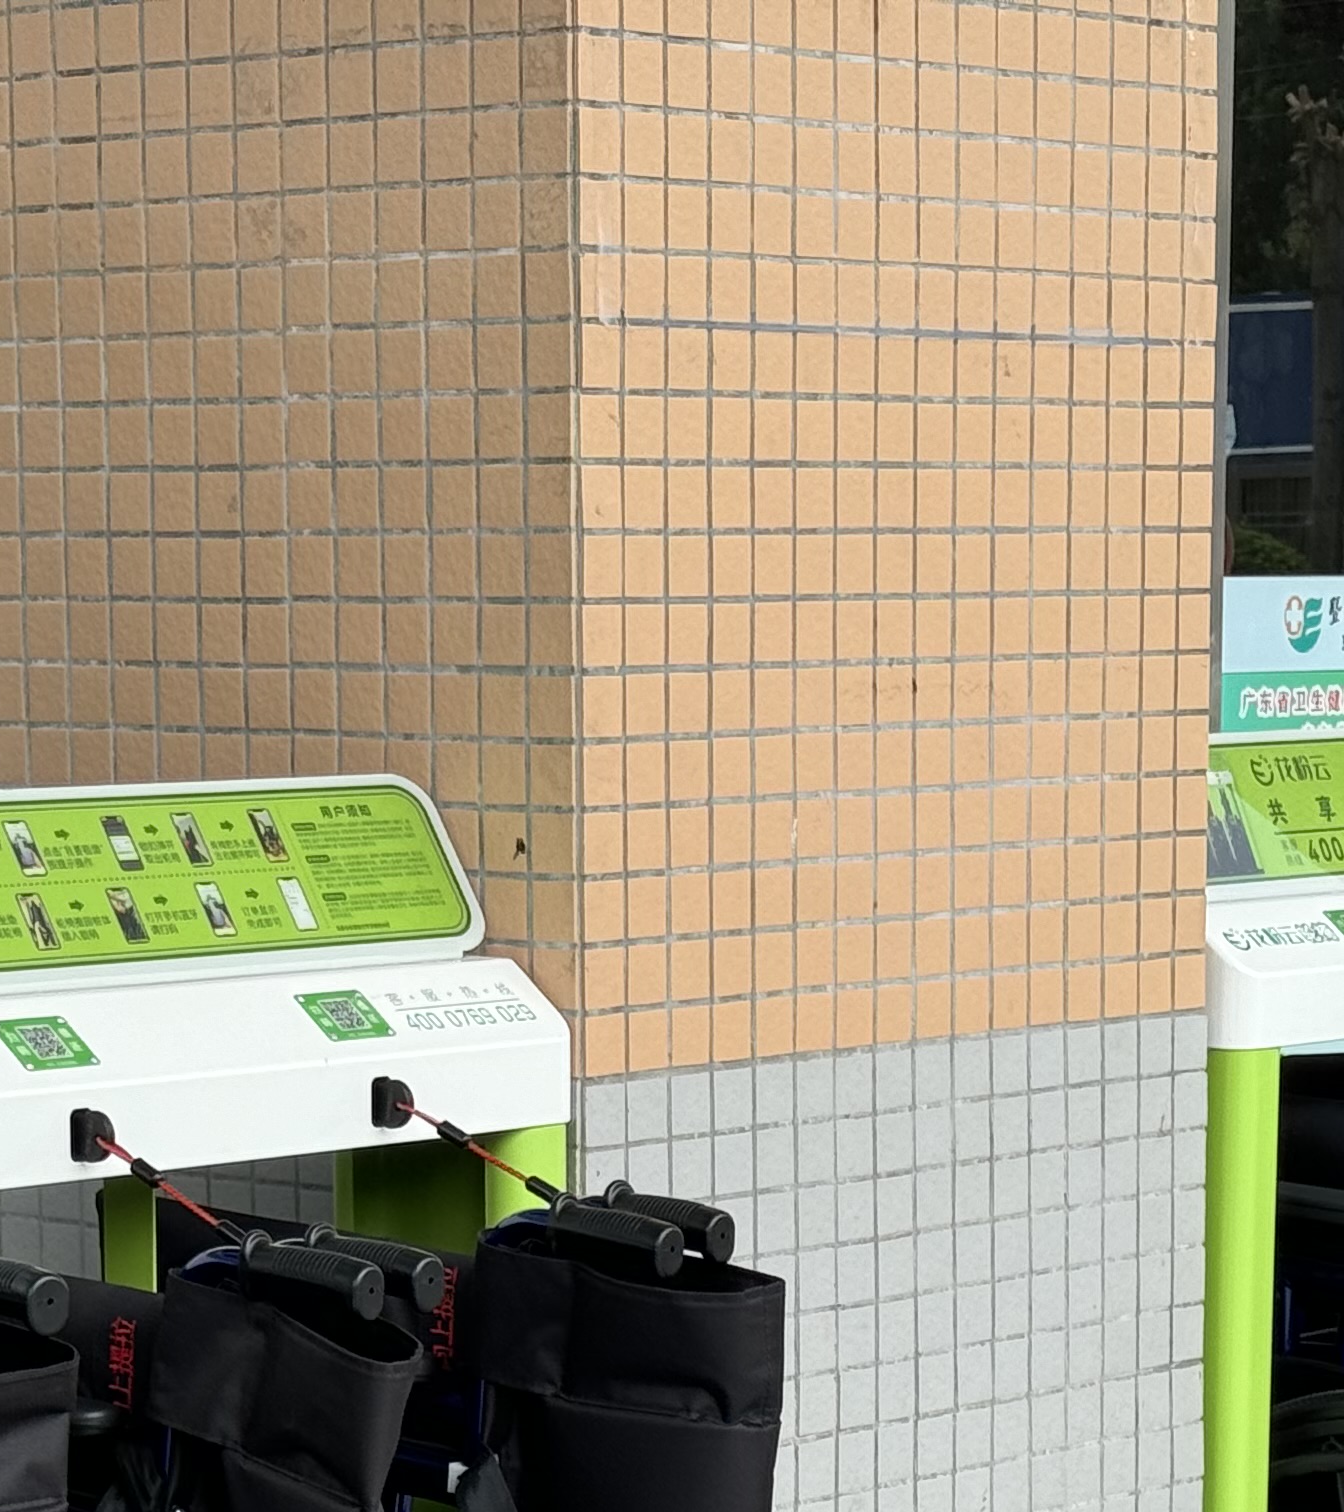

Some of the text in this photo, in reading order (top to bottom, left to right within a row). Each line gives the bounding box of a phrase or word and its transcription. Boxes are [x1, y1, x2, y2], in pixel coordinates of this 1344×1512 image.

[1274, 754, 1332, 782] 花粉云
[1308, 836, 1344, 863] 400
[406, 1003, 537, 1031] 400 0769 029
